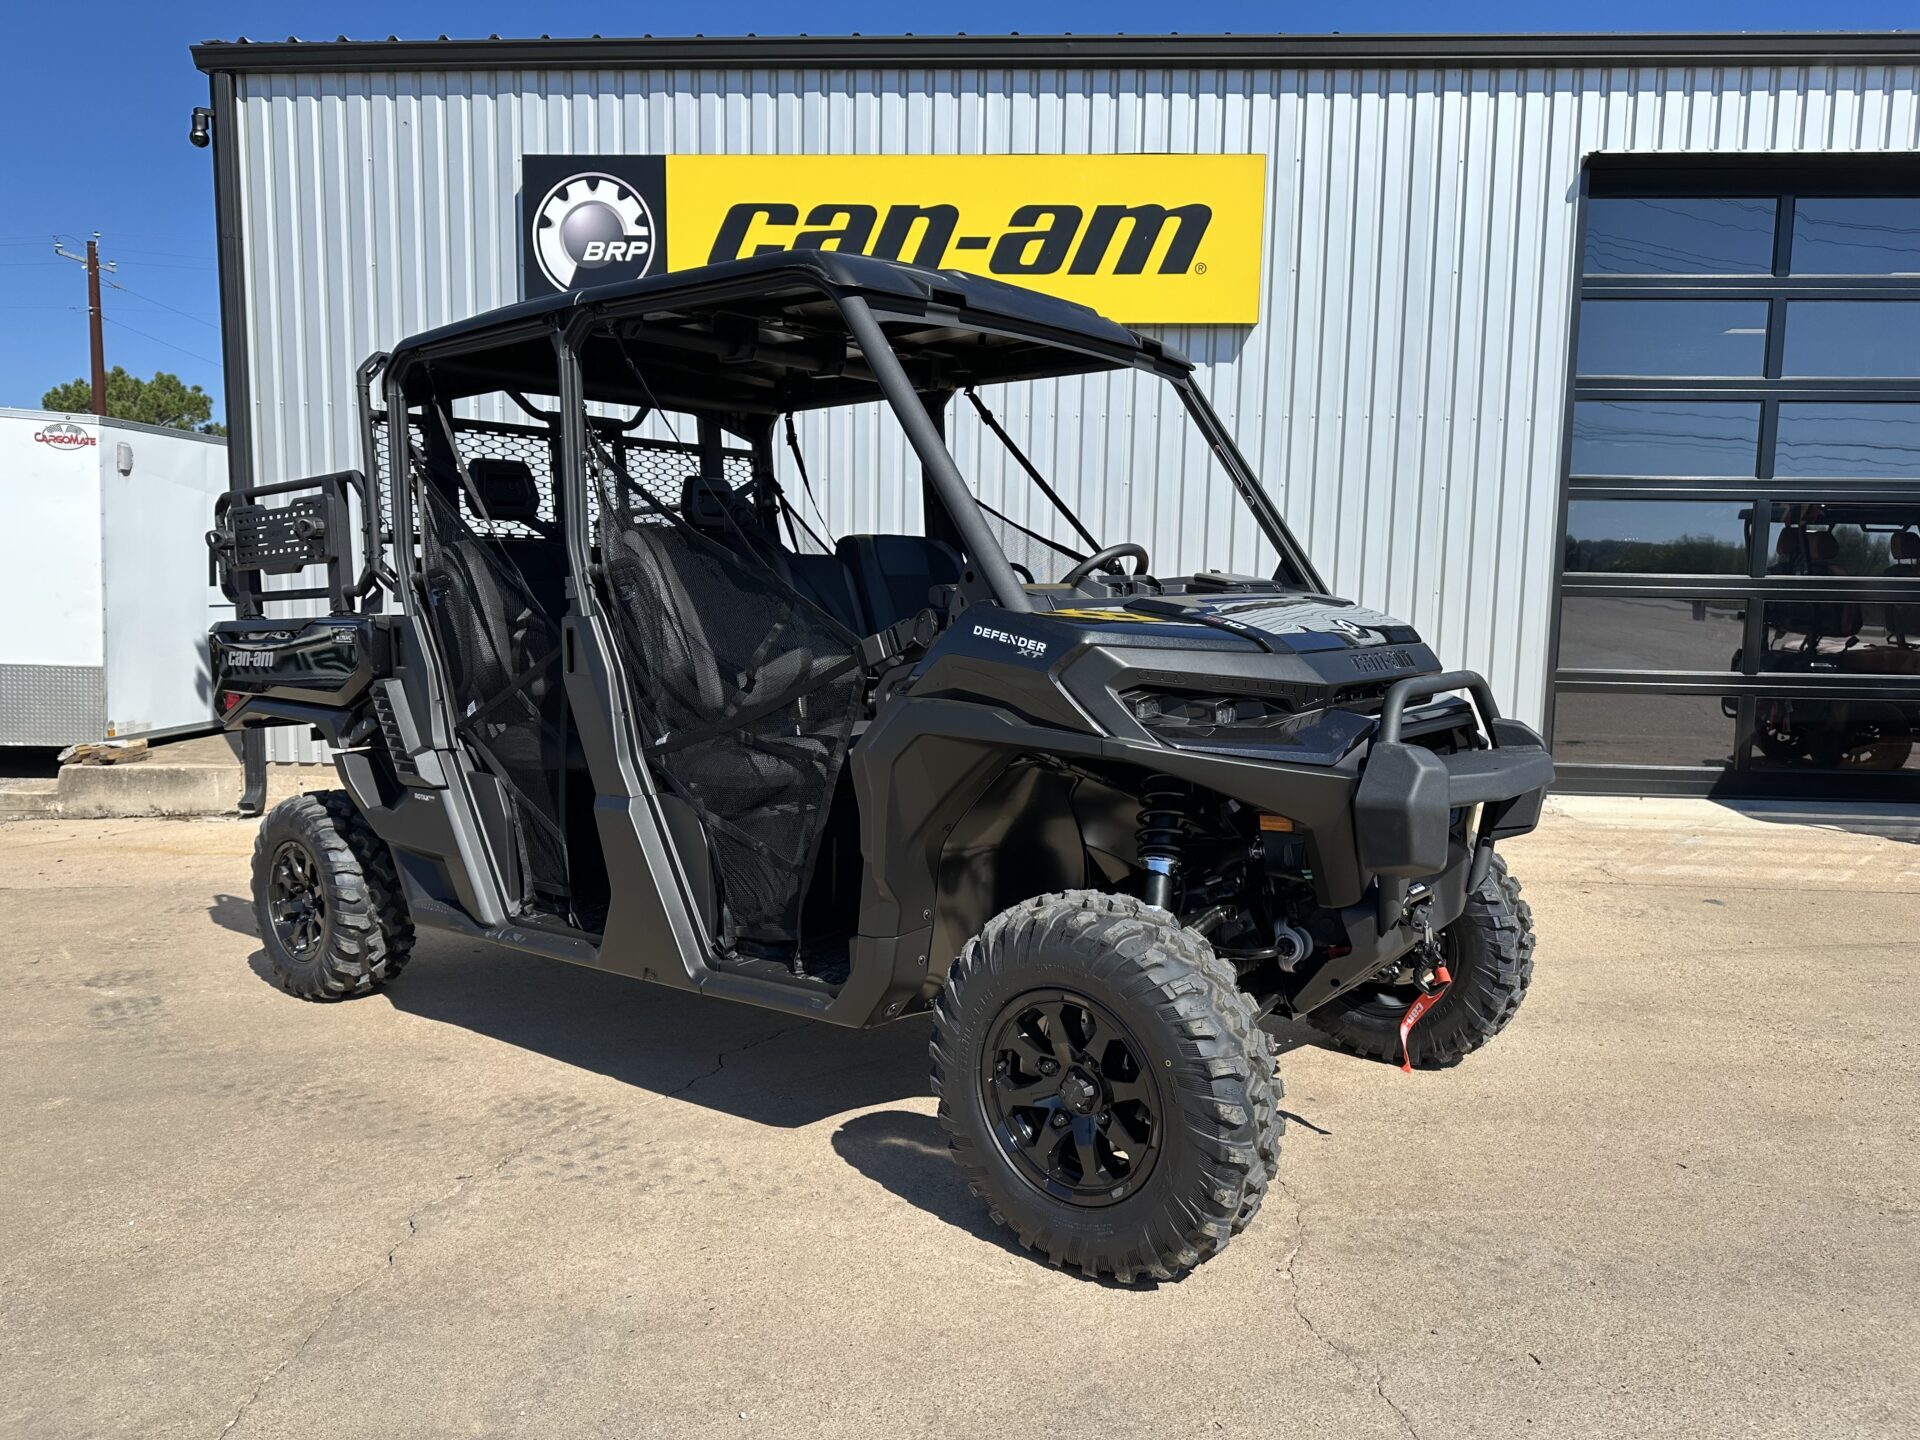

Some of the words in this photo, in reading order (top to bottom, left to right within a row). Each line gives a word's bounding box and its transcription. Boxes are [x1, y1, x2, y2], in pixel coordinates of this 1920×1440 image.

[707, 203, 1212, 275] can-am
[582, 241, 648, 262] BRP
[973, 625, 1047, 653] DEFENDER
[228, 651, 274, 667] can-am
[1016, 647, 1043, 659] XT
